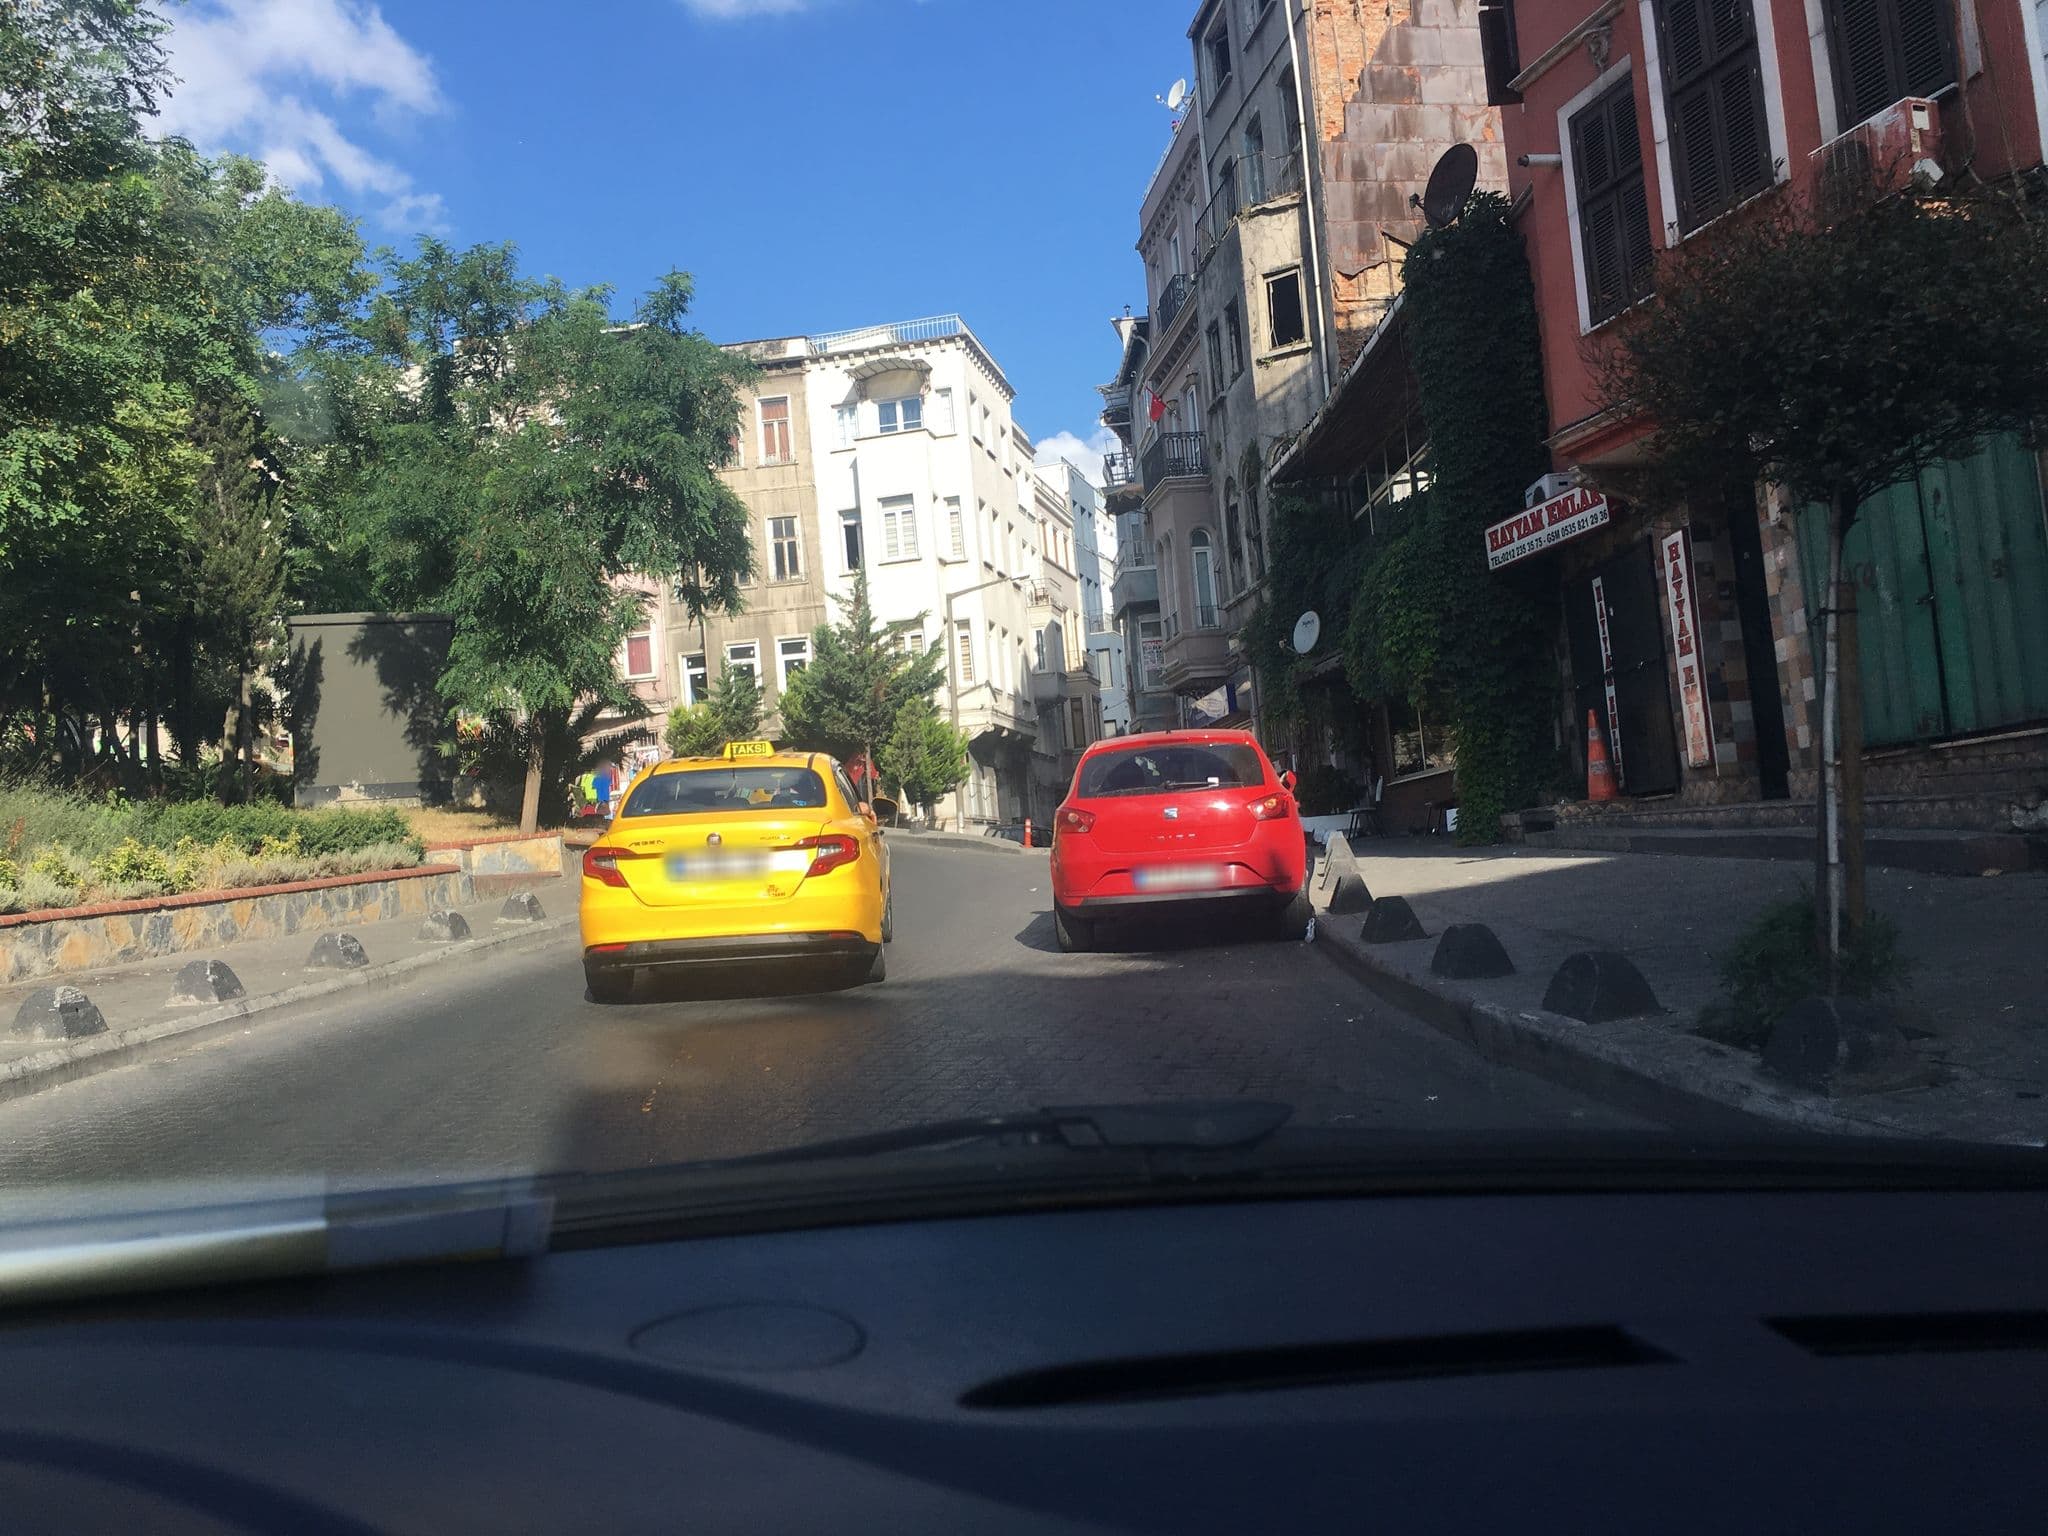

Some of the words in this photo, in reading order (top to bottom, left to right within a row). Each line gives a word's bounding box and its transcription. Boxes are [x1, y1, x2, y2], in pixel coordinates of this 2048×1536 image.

[1488, 509, 1545, 552] HAYYAM
[1546, 488, 1604, 526] EMLAK
[1516, 546, 1526, 557] 235
[1527, 541, 1535, 553] 35
[1535, 537, 1543, 549] 75
[1547, 529, 1560, 543] GSM
[1561, 523, 1576, 537] 0535
[1577, 518, 1589, 530] 821
[1590, 513, 1599, 525] 29
[1600, 509, 1608, 521] 36
[1668, 541, 1693, 657] HAYYAM
[1683, 665, 1706, 761] EMLAK
